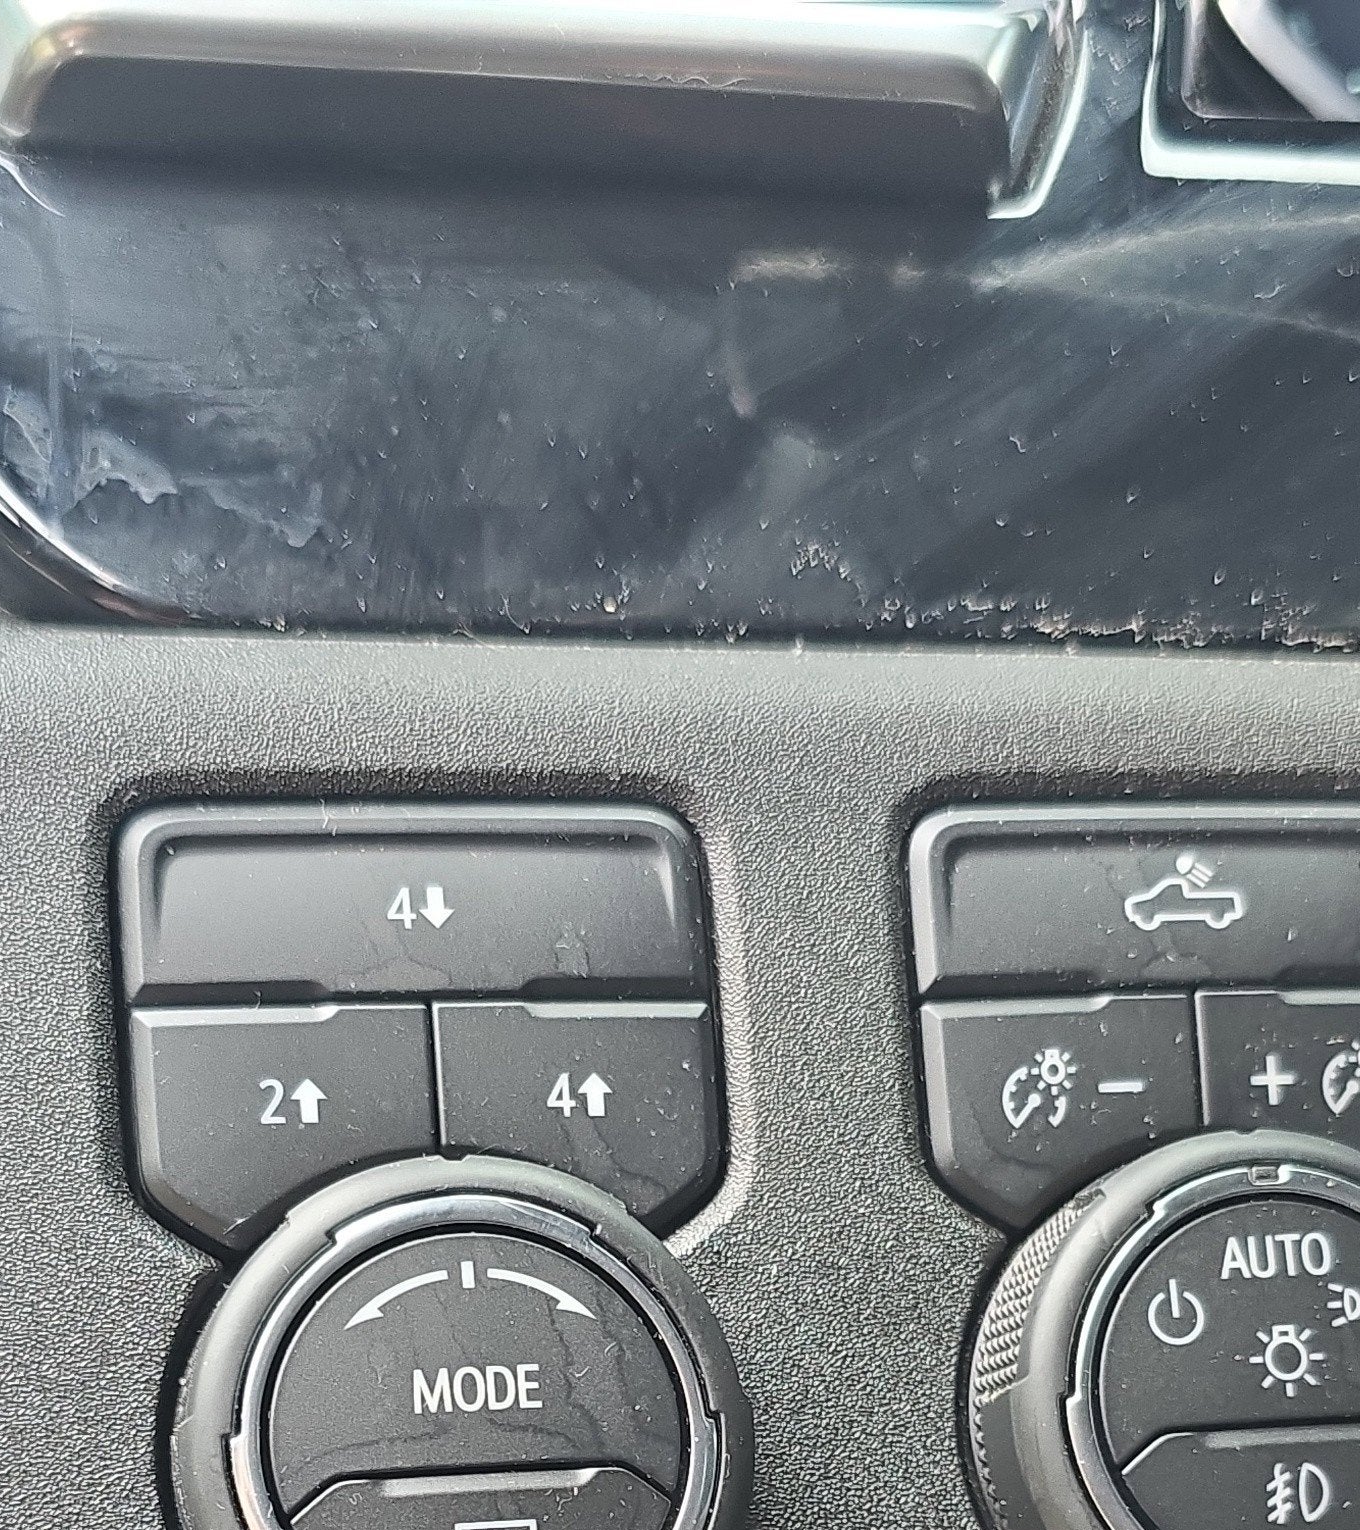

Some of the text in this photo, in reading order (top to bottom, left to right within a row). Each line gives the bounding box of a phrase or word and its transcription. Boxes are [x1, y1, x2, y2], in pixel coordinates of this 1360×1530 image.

[386, 887, 417, 930] 4
[258, 1078, 287, 1125] 2
[546, 1073, 576, 1117] 4
[1220, 1232, 1331, 1280] AUTO
[412, 1362, 544, 1415] MODE
